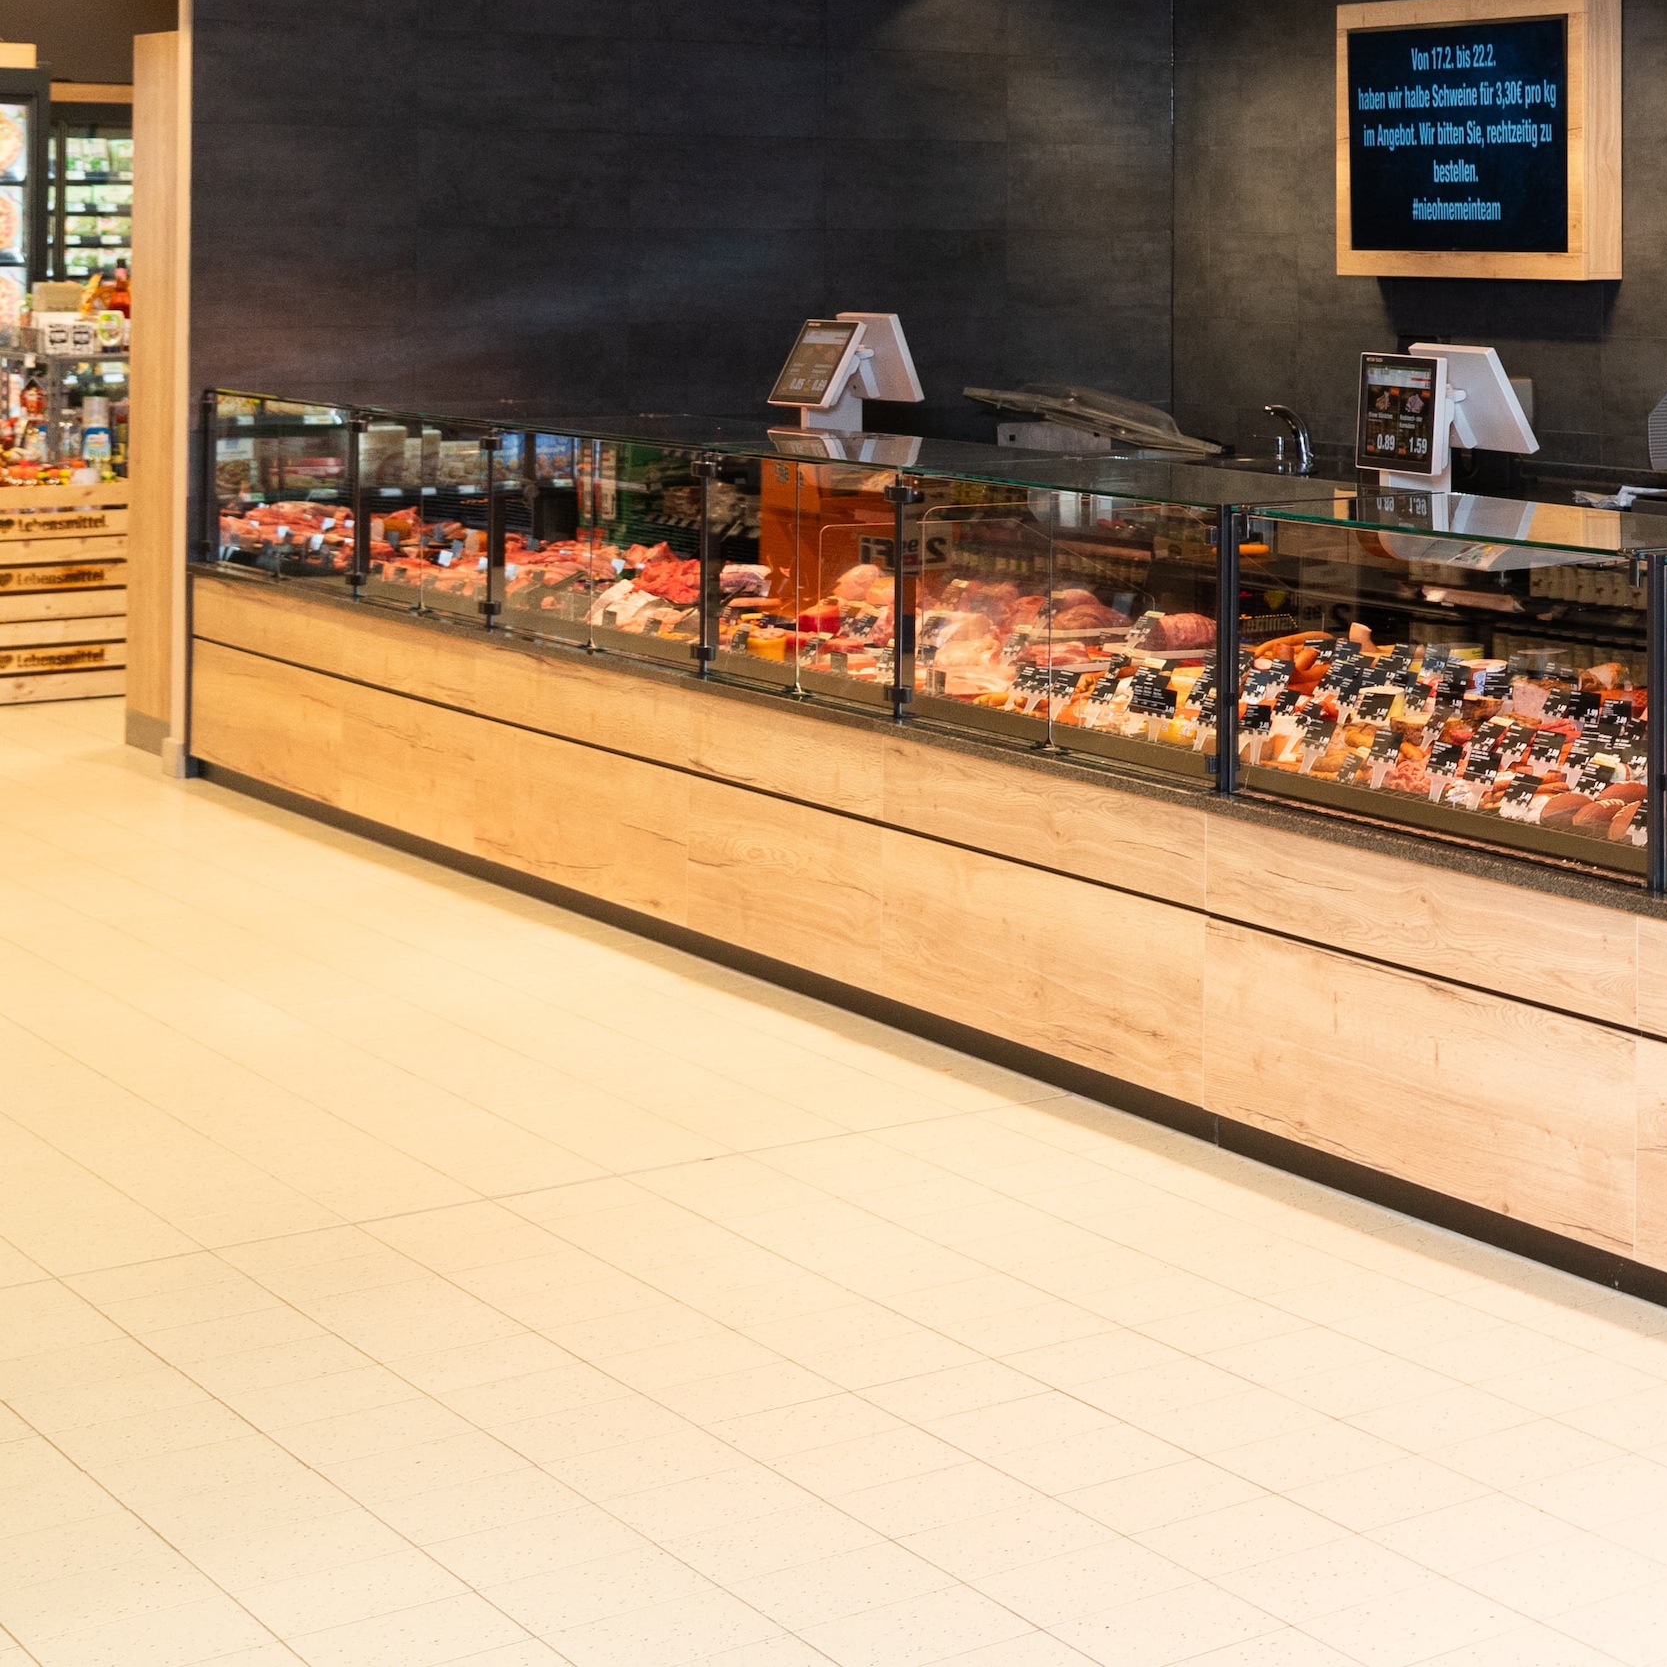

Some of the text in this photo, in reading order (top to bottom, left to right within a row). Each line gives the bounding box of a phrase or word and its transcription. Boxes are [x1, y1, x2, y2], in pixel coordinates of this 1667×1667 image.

[1411, 44, 1496, 70] Von 17.2. bis 22.2.
[1358, 80, 1556, 110] haben wir halbe Schweine für 3,30€ pro kg
[1363, 119, 1552, 152] im Angebot. Wir bitten Sie, rechtzeitig zu
[1433, 160, 1479, 182] bestellen.
[1412, 197, 1500, 220] #nieohnemeinteam
[1377, 434, 1395, 450] 0.89
[1409, 437, 1428, 454] 1.59
